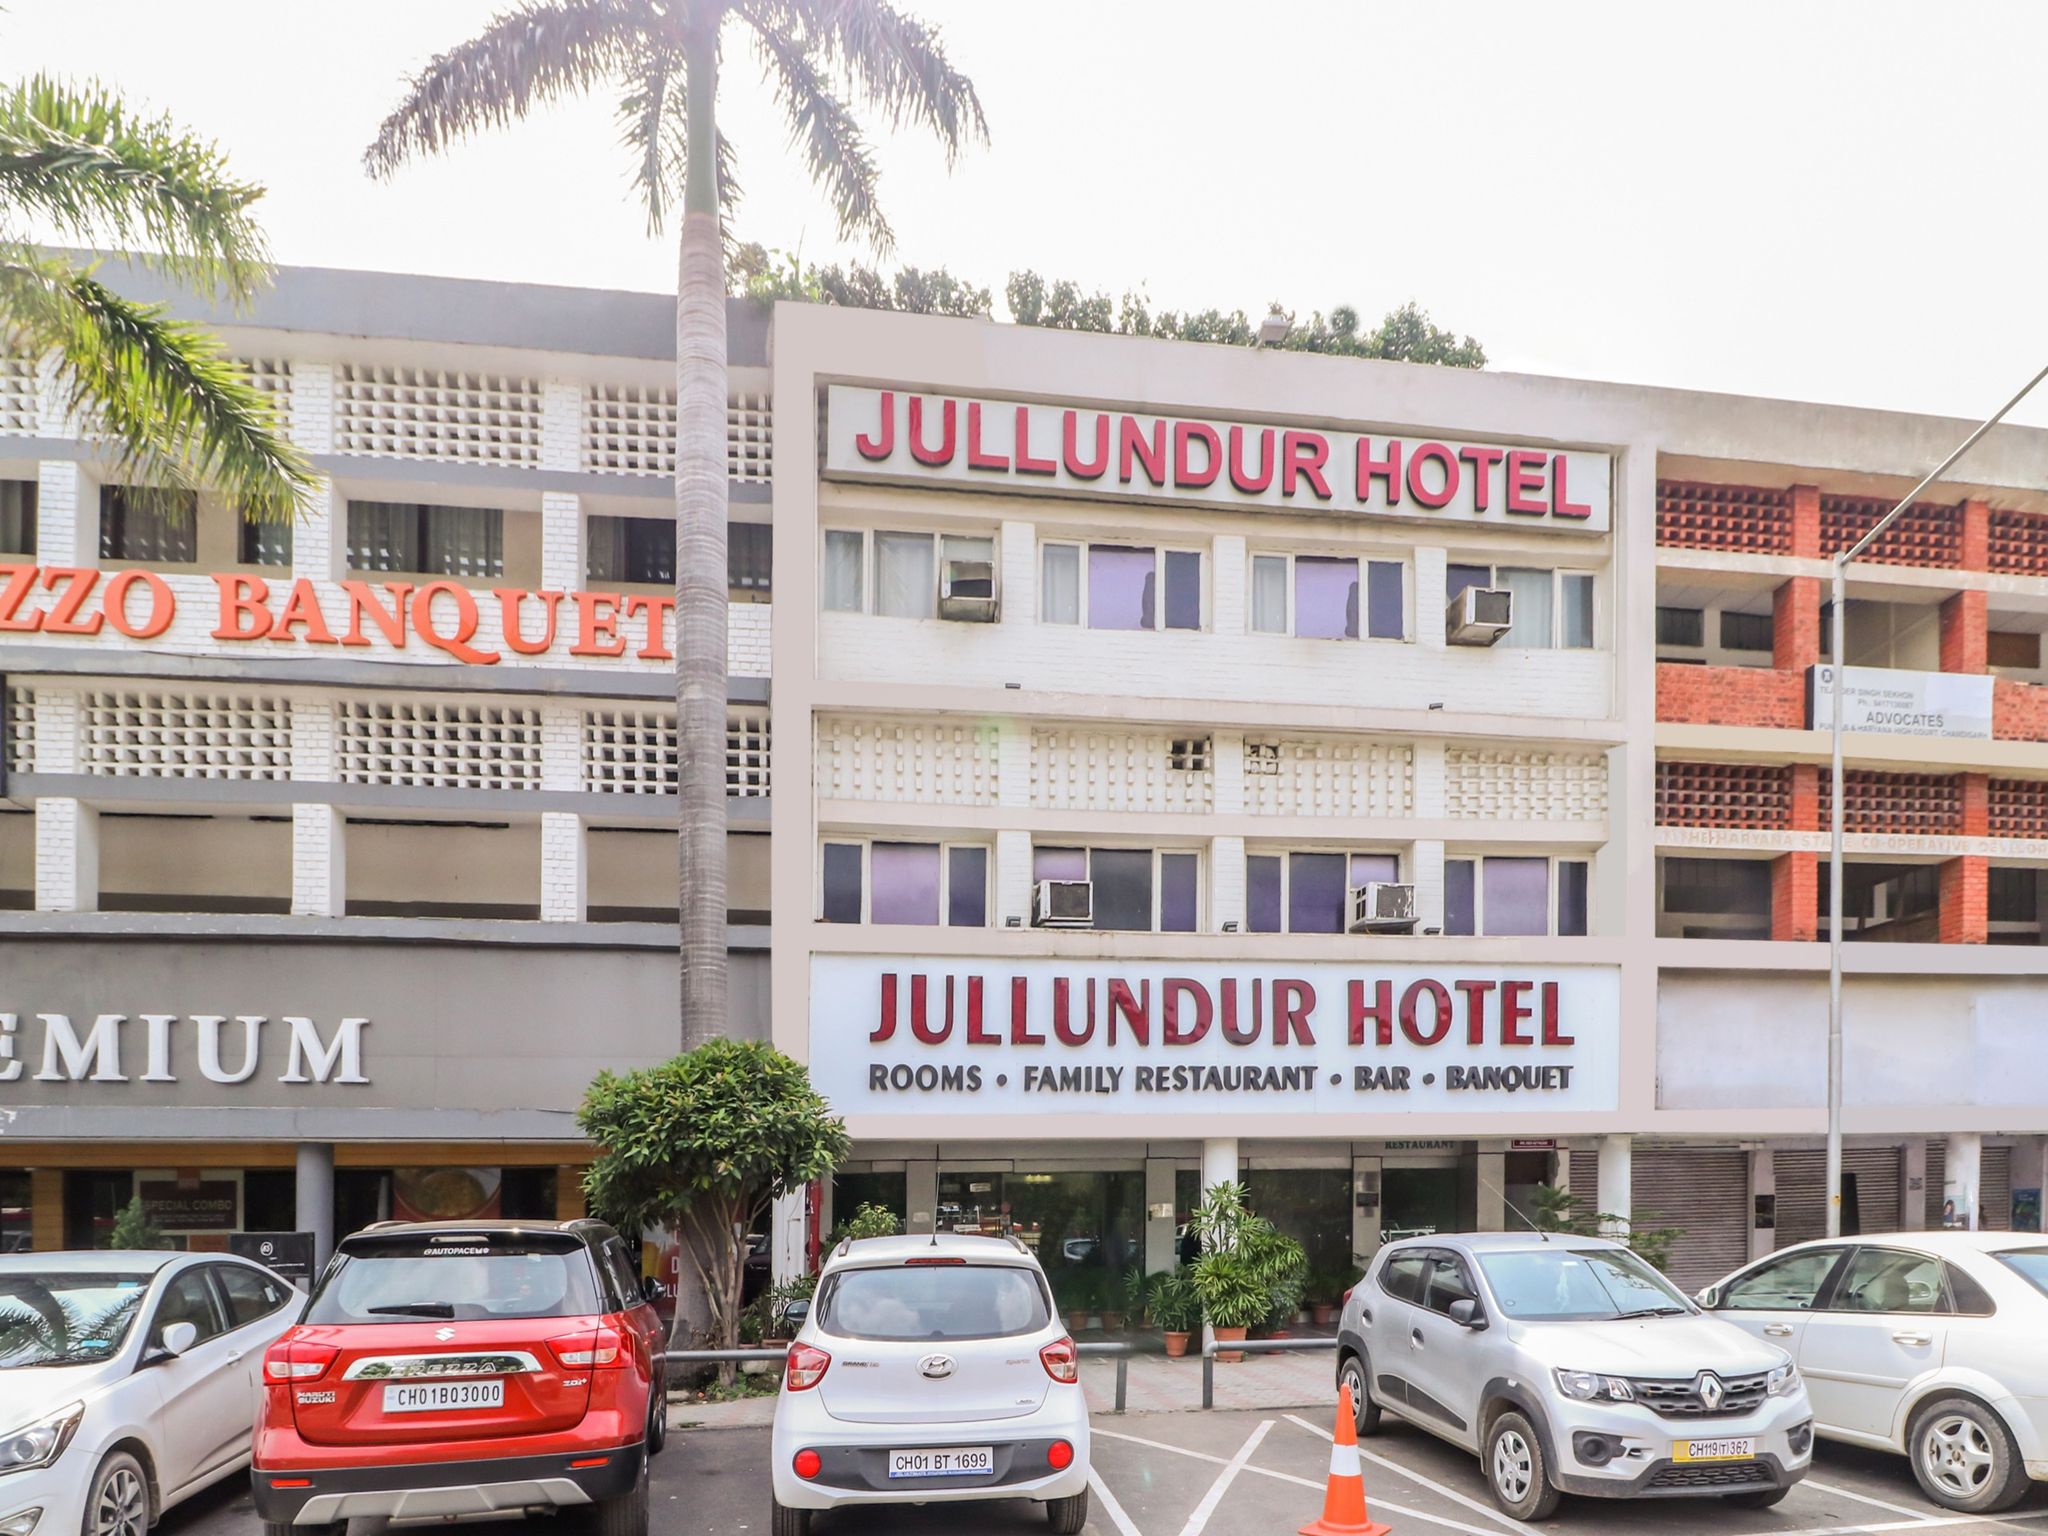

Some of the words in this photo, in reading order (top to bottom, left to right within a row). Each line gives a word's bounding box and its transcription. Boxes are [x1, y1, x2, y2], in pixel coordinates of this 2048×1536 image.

[855, 391, 1332, 500] JULLUNDUR
[1355, 436, 1592, 520] HOTEL
[210, 570, 676, 666] BANQUET
[1866, 711, 1944, 728] ADVOCATES
[1802, 834, 1852, 848] STAE
[869, 973, 1317, 1048] JULLUNDUR
[1347, 978, 1576, 1047] HOTEL
[869, 1064, 982, 1094] ROOMS
[1023, 1065, 1123, 1096] FAMILY
[1135, 1064, 1318, 1093] RESTAURANT
[1354, 1065, 1412, 1093] BAR
[1446, 1064, 1574, 1093] BANQUET
[1385, 1140, 1455, 1150] RESTAURANT
[145, 1199, 190, 1211] SPECIAL
[192, 1199, 233, 1211] COMBO
[389, 1362, 497, 1377] BREZZA
[398, 1385, 500, 1406] CH01BQ3000
[896, 1455, 929, 1470] CH01
[934, 1455, 950, 1470] BT
[955, 1453, 987, 1469] 1699
